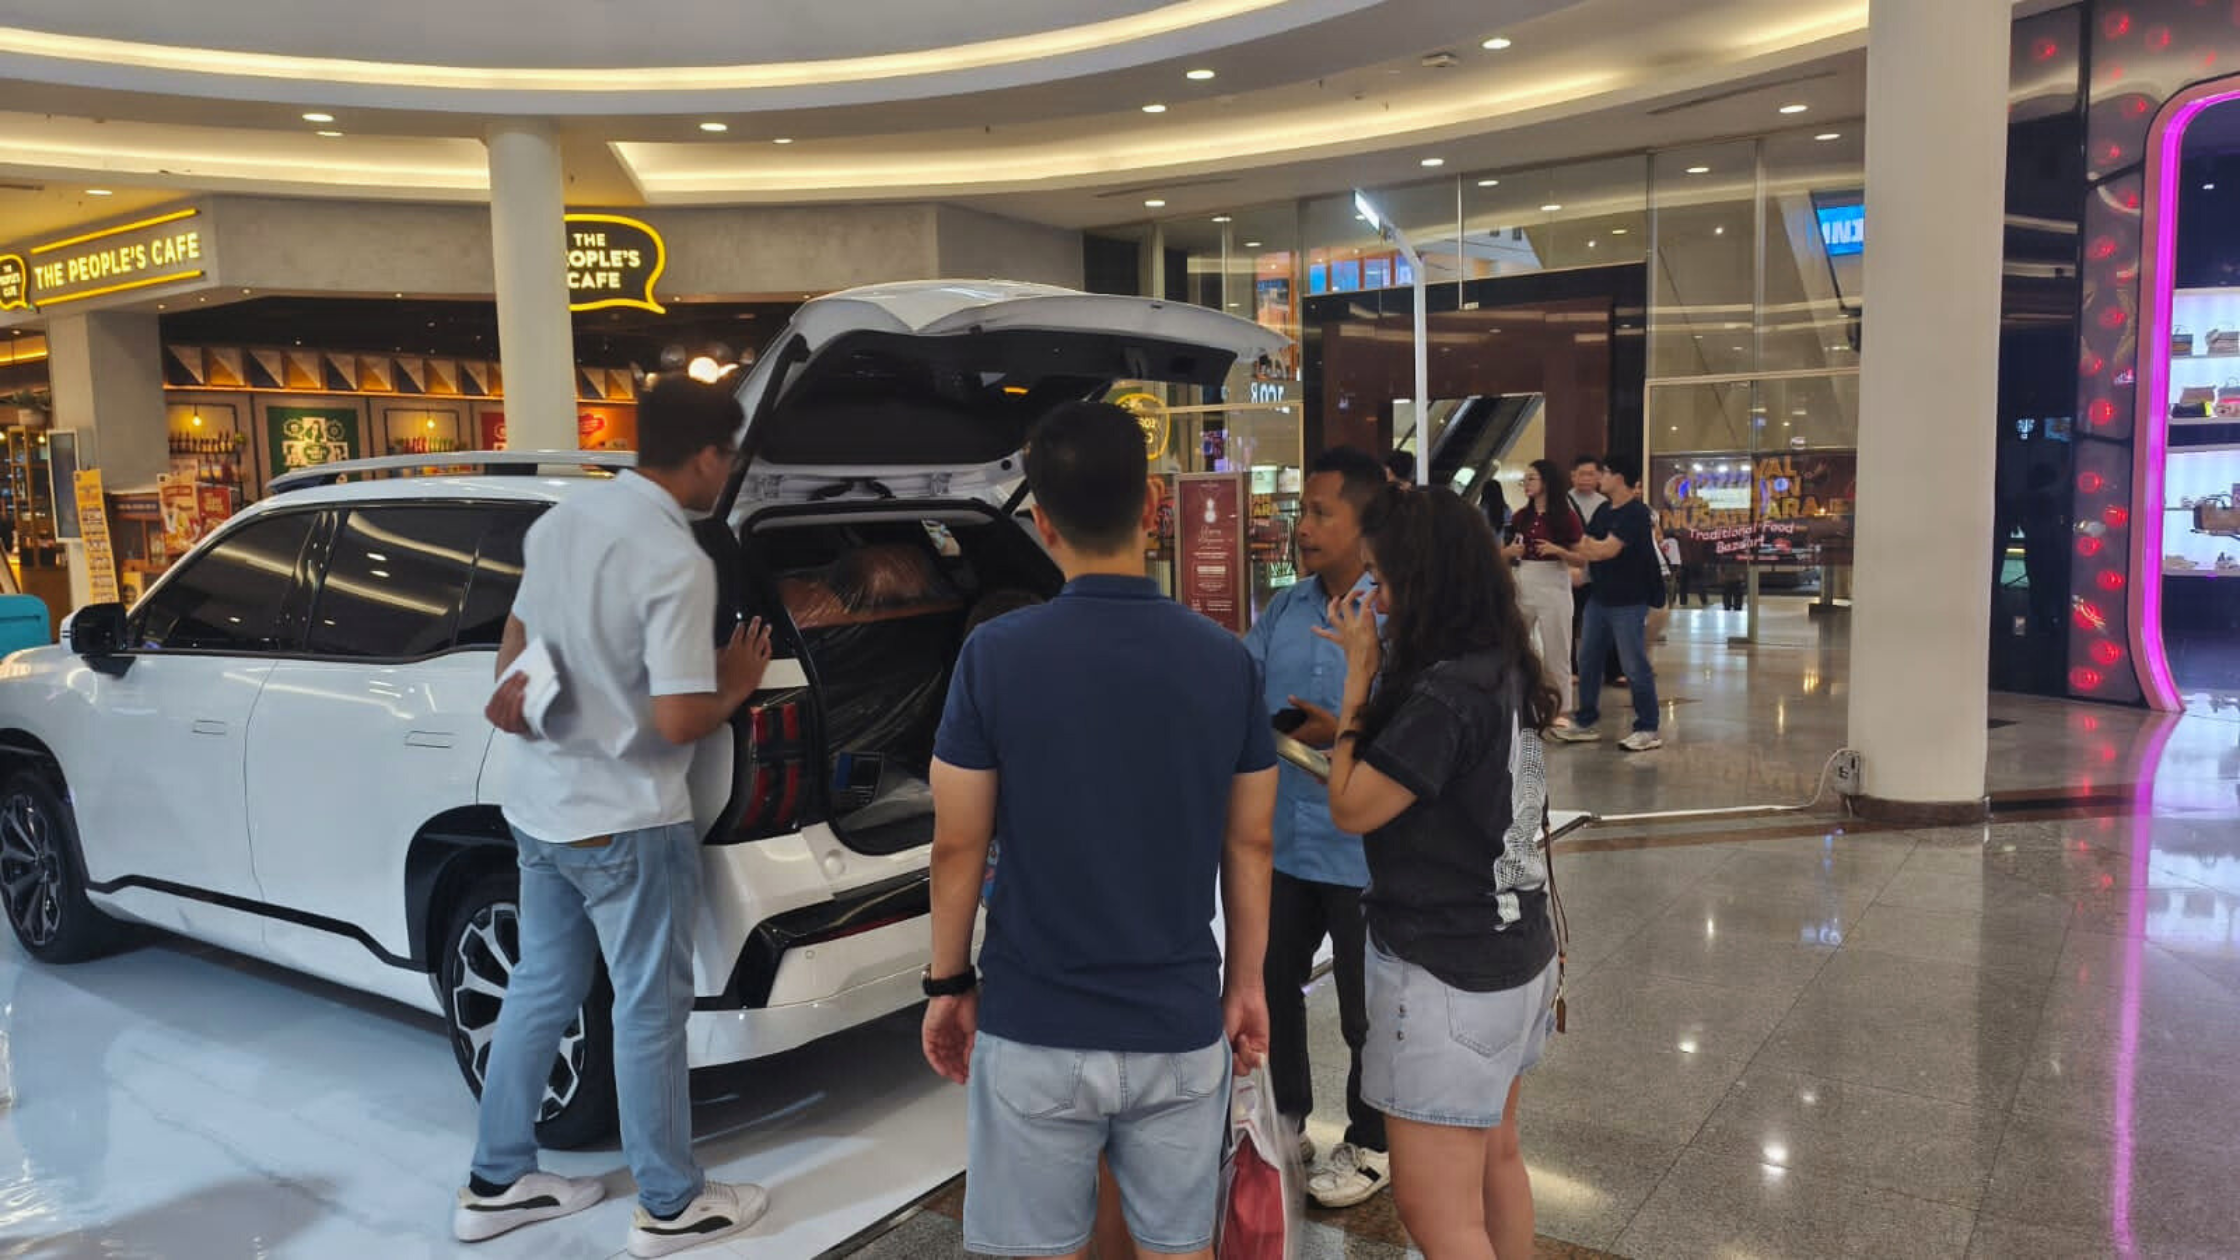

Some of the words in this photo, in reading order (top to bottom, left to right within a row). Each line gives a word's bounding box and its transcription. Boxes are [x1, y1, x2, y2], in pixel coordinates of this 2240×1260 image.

[572, 233, 606, 247] THE
[34, 262, 65, 290] THE
[68, 244, 147, 282] PEOPLE'S
[151, 232, 200, 265] CAFE
[565, 249, 641, 268] OPLE'S
[566, 271, 621, 289] CAFE
[1690, 521, 1758, 542] Traditional
[1762, 519, 1796, 534] Food
